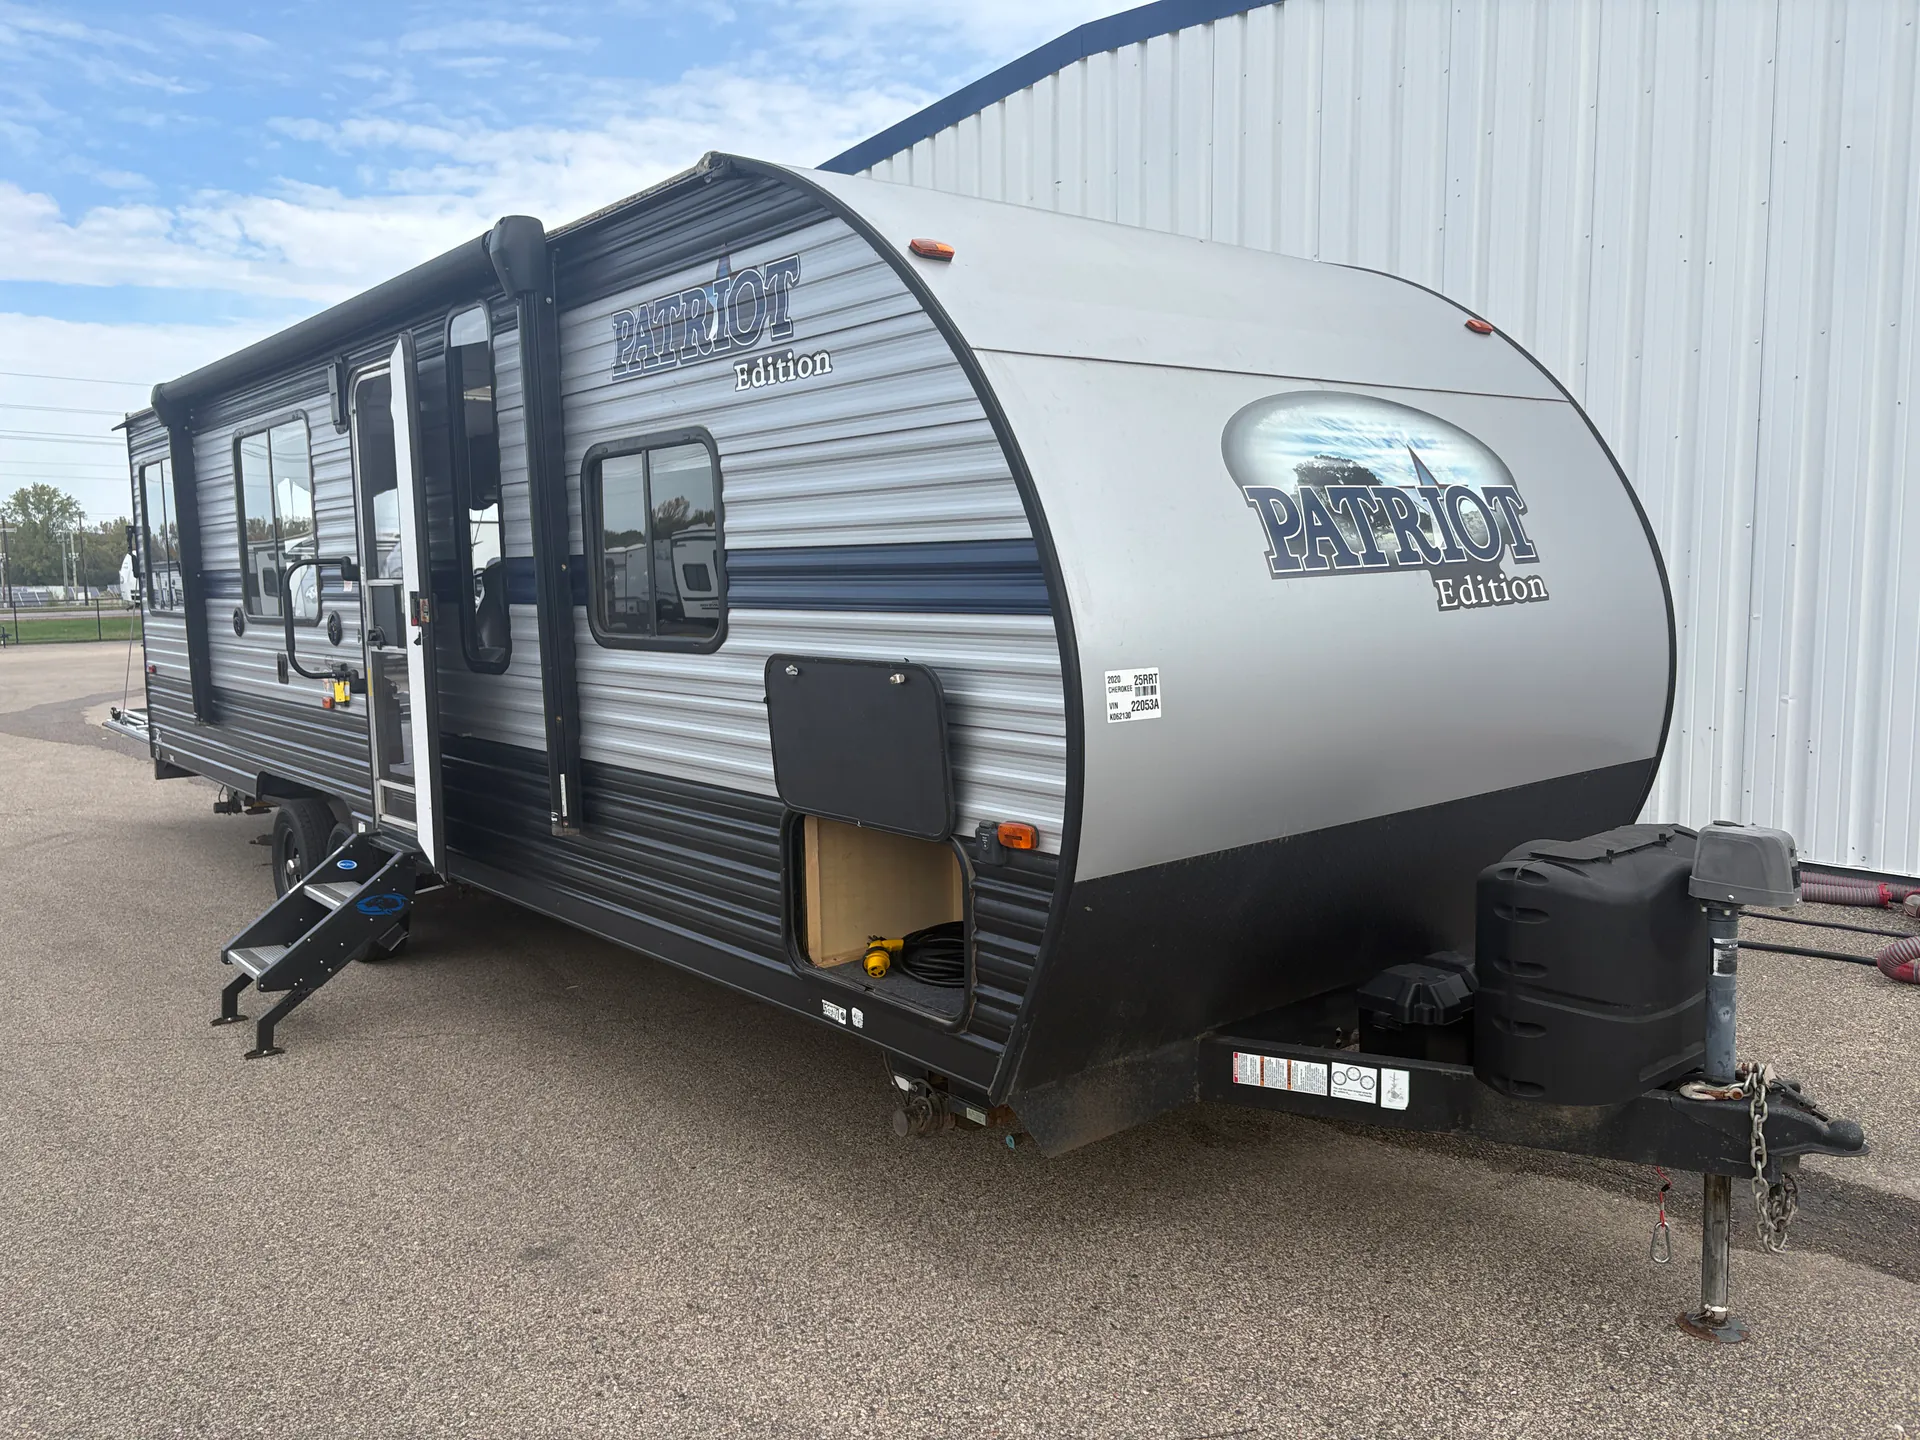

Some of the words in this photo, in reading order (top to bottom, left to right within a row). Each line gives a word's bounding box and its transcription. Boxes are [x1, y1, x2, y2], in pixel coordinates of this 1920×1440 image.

[612, 253, 800, 380] PATRIOT
[734, 350, 832, 391] Edition
[1243, 485, 1538, 576] PATRIOT
[1436, 573, 1548, 608] Edition
[1107, 675, 1121, 684] 2020
[1134, 673, 1158, 686] 25RRT
[1108, 685, 1132, 694] CHEROKEE
[1109, 702, 1118, 710] VIN
[1131, 698, 1159, 712] 22053A
